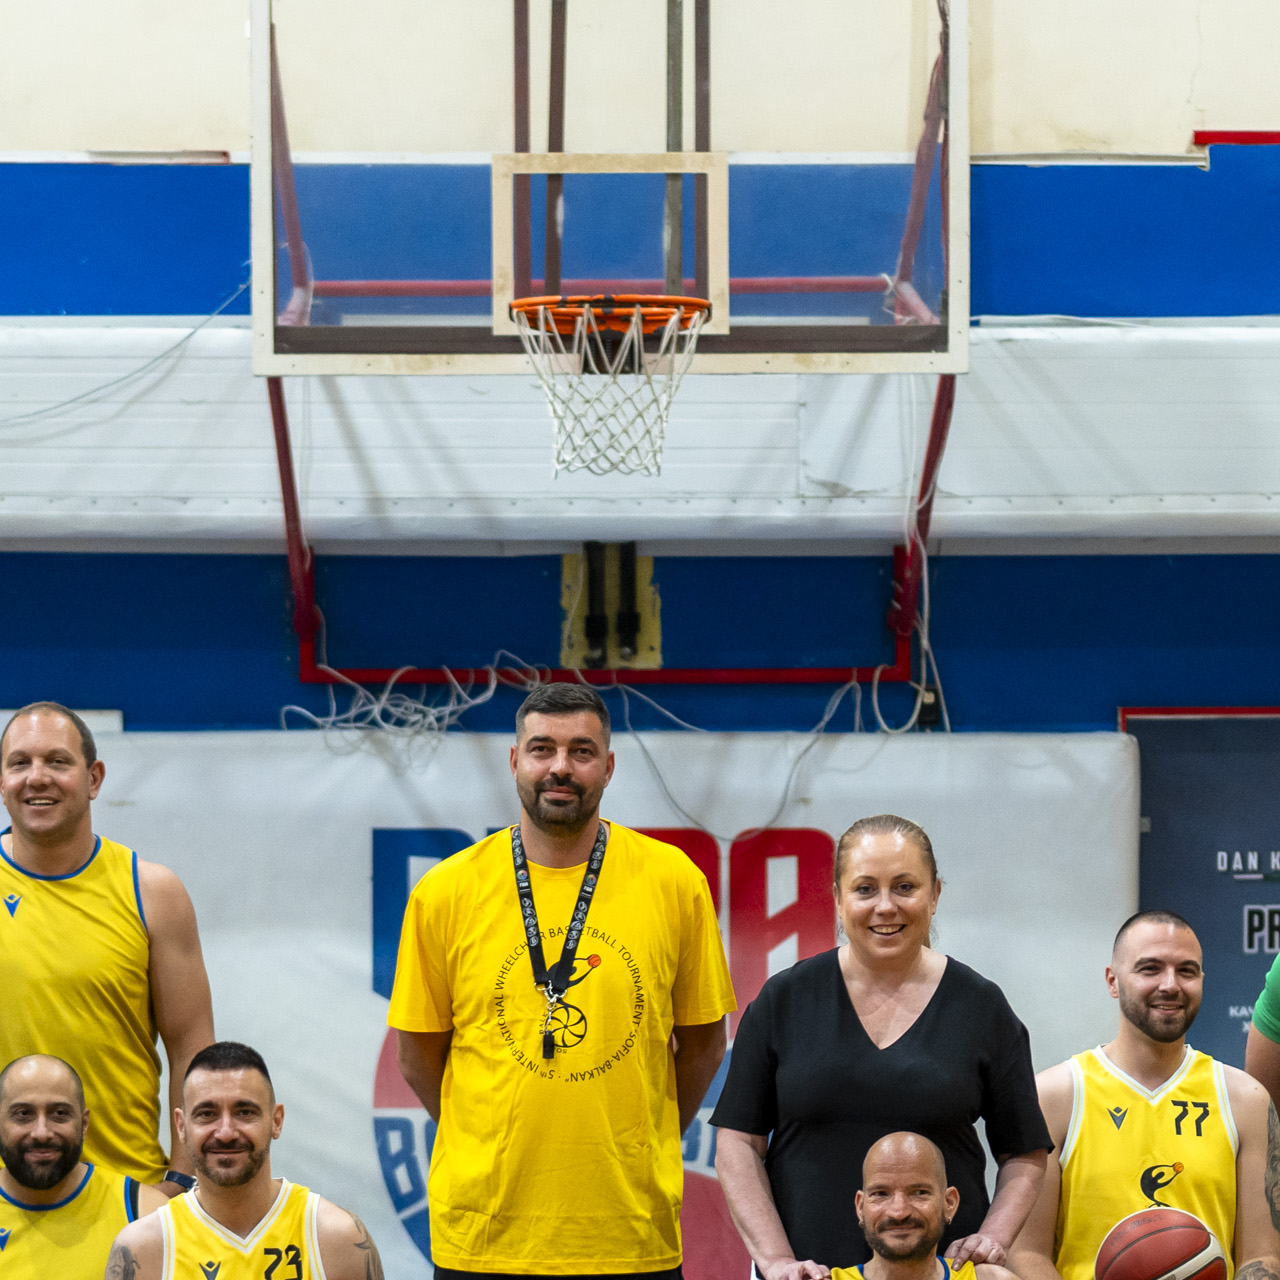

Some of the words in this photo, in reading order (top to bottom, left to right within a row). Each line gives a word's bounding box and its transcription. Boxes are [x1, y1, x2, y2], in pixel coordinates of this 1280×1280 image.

[1217, 851, 1258, 871] DAN
[494, 931, 547, 991] WHEELCHR
[548, 926, 618, 949] BASTBALL
[617, 945, 645, 1028] TOURNAMENT
[1171, 1100, 1210, 1137] 77
